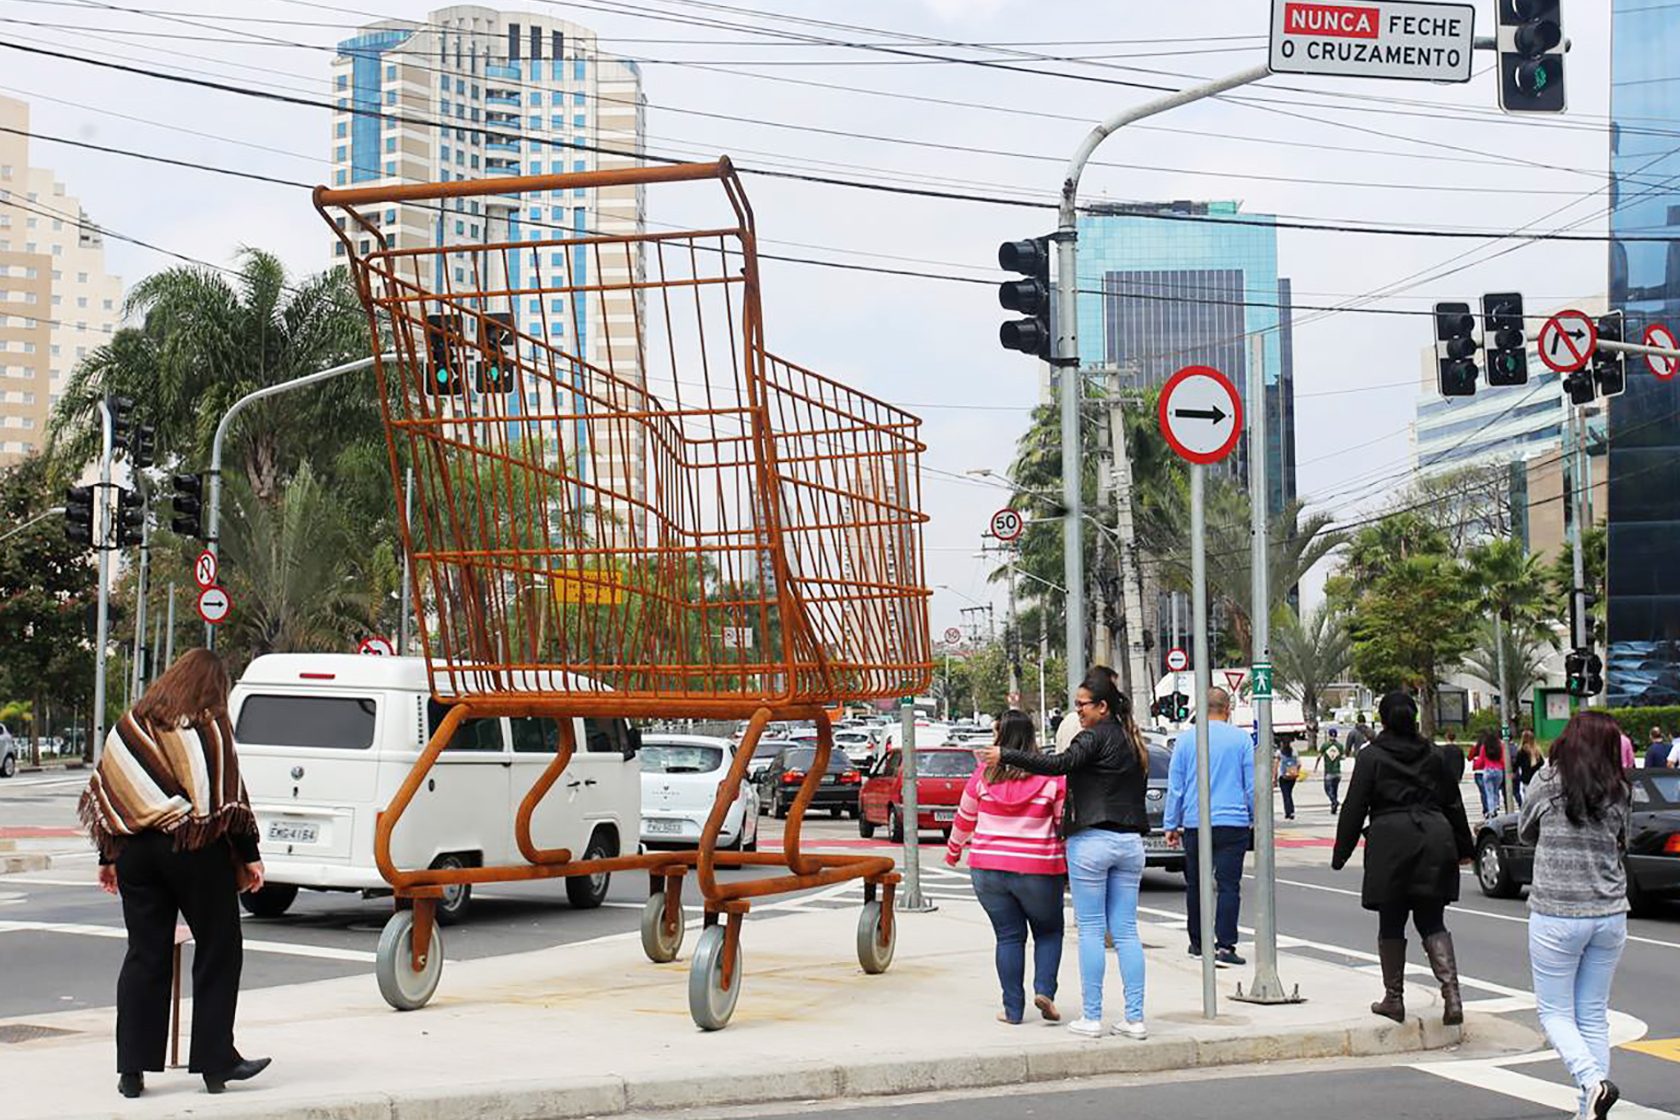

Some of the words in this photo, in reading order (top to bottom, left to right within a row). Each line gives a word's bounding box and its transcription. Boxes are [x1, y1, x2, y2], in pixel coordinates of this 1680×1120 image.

[1291, 9, 1371, 33] NUNCA
[1389, 15, 1462, 37] FECHE
[1281, 40, 1295, 58] O
[1307, 41, 1460, 68] CRUZAMENTO
[996, 514, 1017, 530] 50
